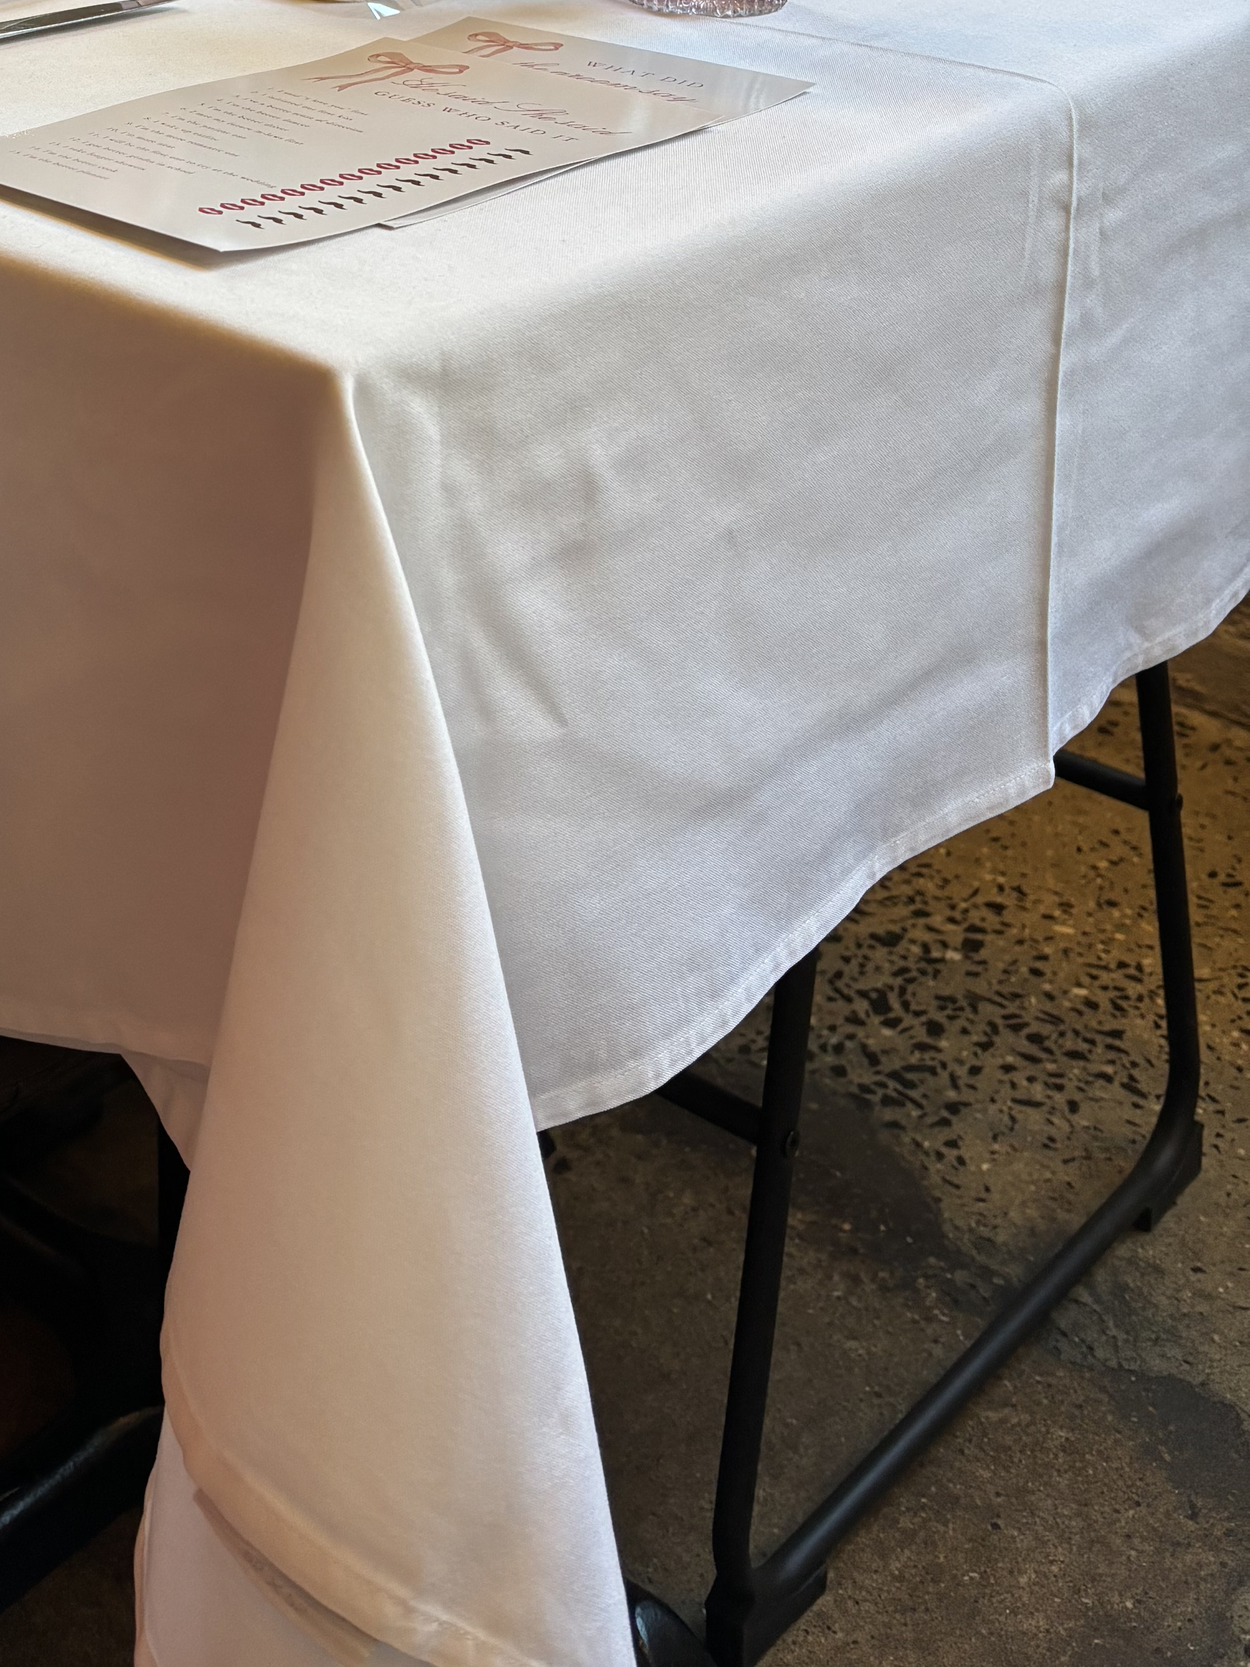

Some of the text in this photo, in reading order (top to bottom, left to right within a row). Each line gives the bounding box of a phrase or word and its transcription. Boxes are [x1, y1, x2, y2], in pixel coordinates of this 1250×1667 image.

[587, 61, 704, 88] WHAT DID
[374, 90, 579, 142] GUESS WHO SAID IT
[436, 91, 510, 105] said
[493, 102, 570, 121] She
[554, 120, 633, 135] said
